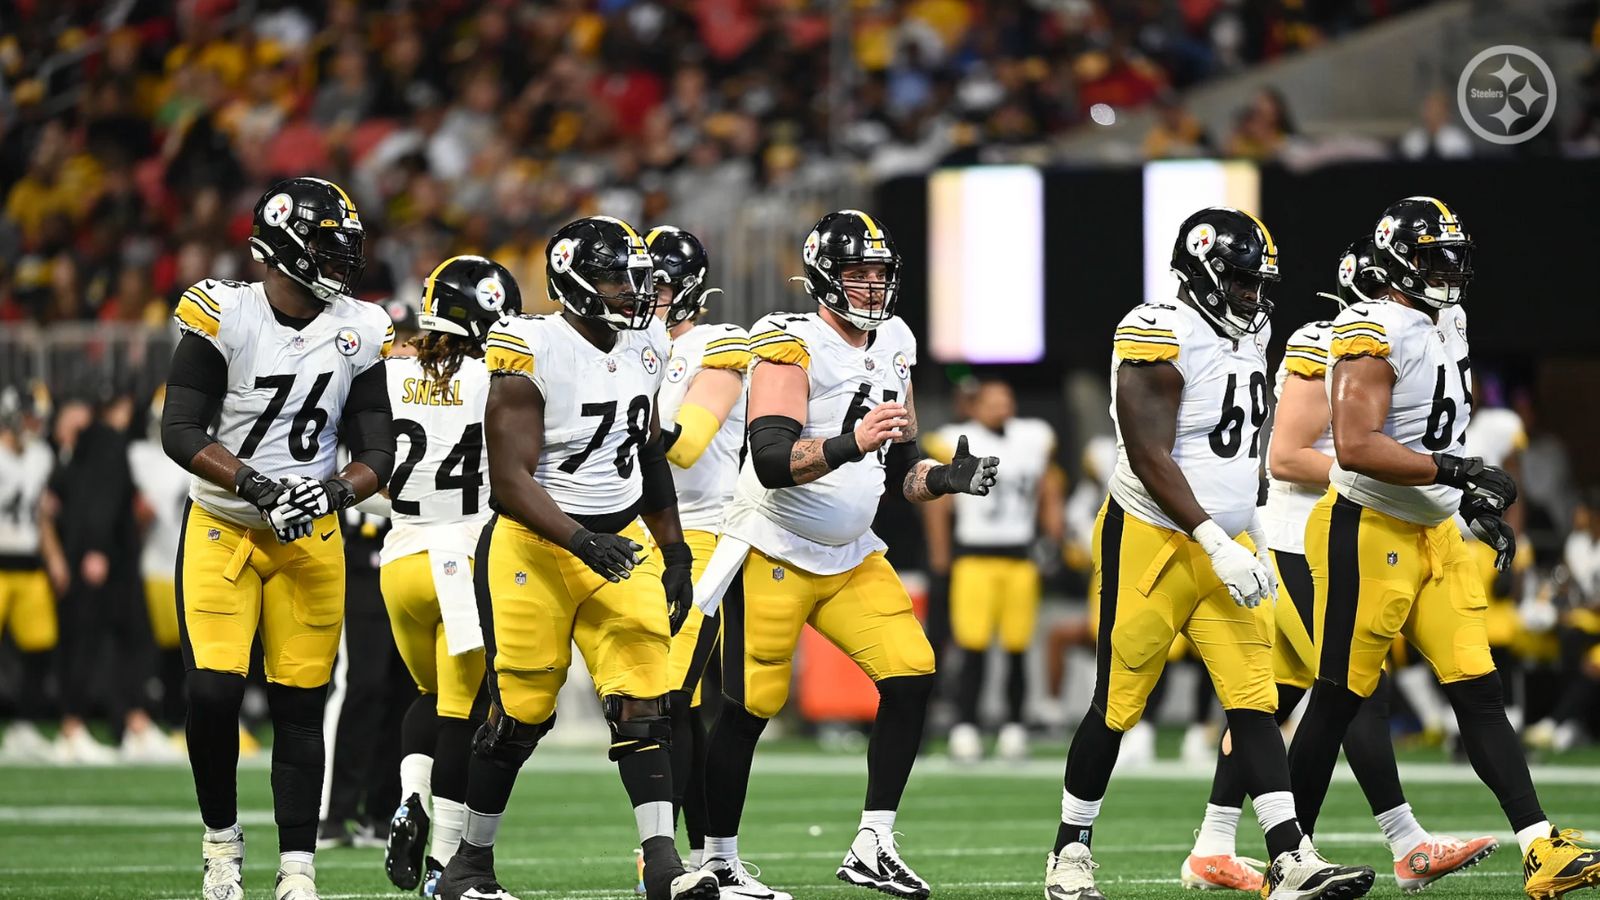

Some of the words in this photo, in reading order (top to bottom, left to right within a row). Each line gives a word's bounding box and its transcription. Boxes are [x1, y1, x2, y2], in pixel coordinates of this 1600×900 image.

[236, 371, 335, 463] 76
[402, 377, 464, 406] SNELL
[1208, 371, 1269, 459] 69
[388, 418, 484, 517] 24
[557, 394, 651, 481] 78
